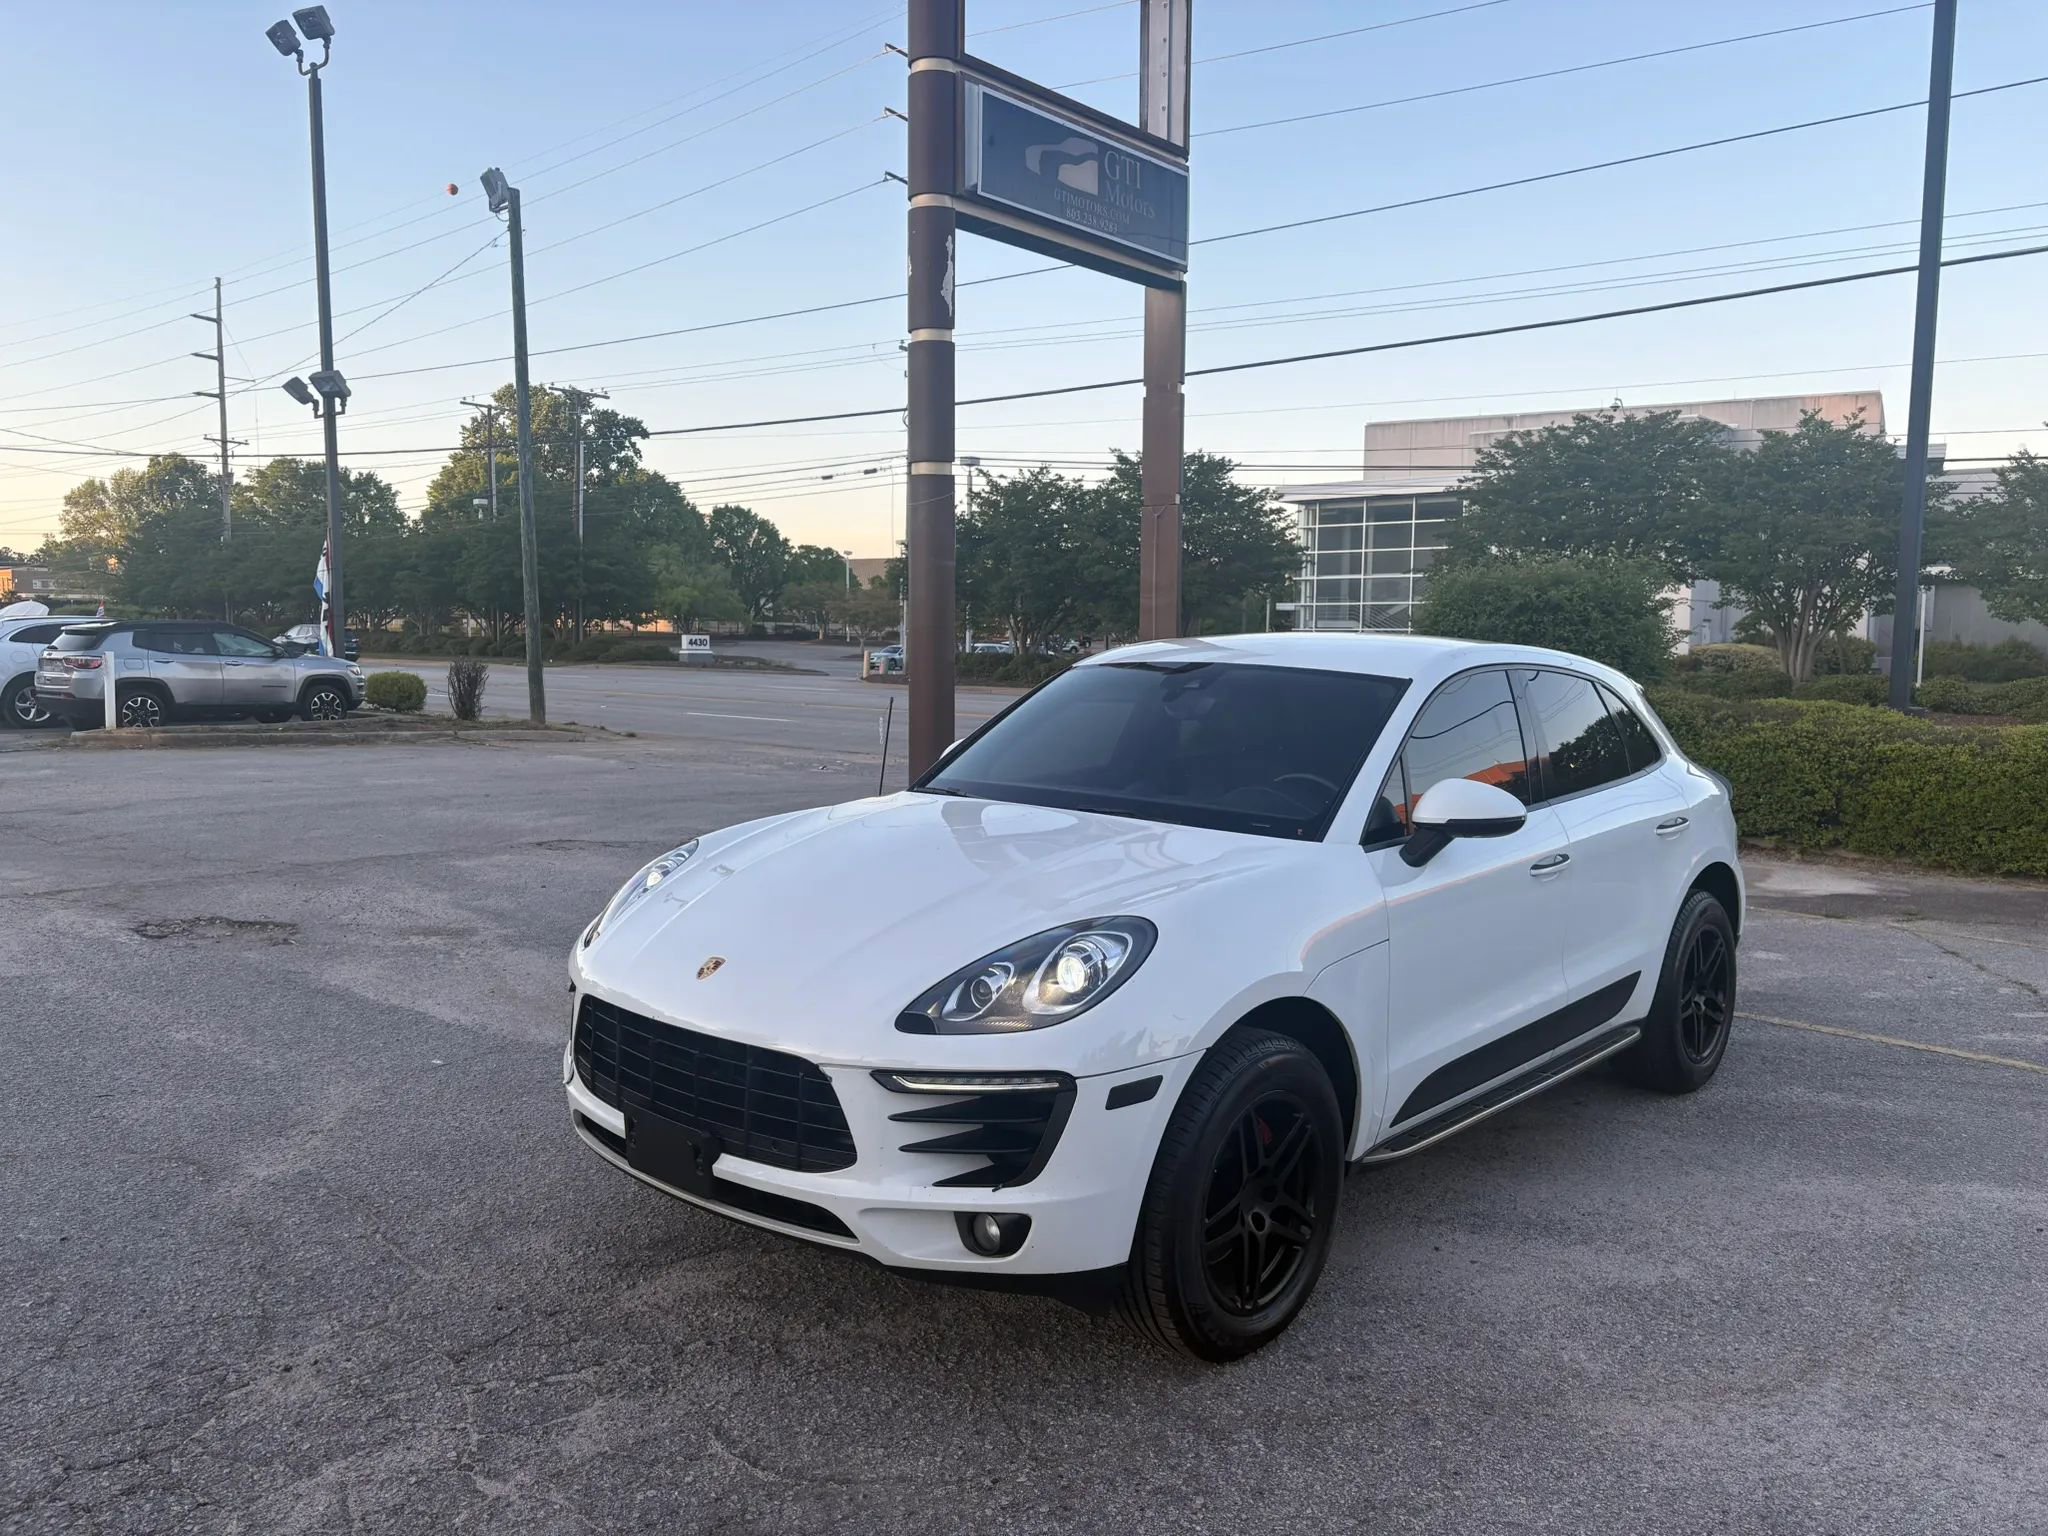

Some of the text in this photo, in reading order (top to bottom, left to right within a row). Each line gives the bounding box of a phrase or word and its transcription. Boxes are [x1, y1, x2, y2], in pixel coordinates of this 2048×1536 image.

[1104, 150, 1141, 189] GTI
[1054, 187, 1130, 224] GTIMOTORS.COM
[1105, 180, 1155, 218] Motors
[688, 638, 708, 647] 4430
